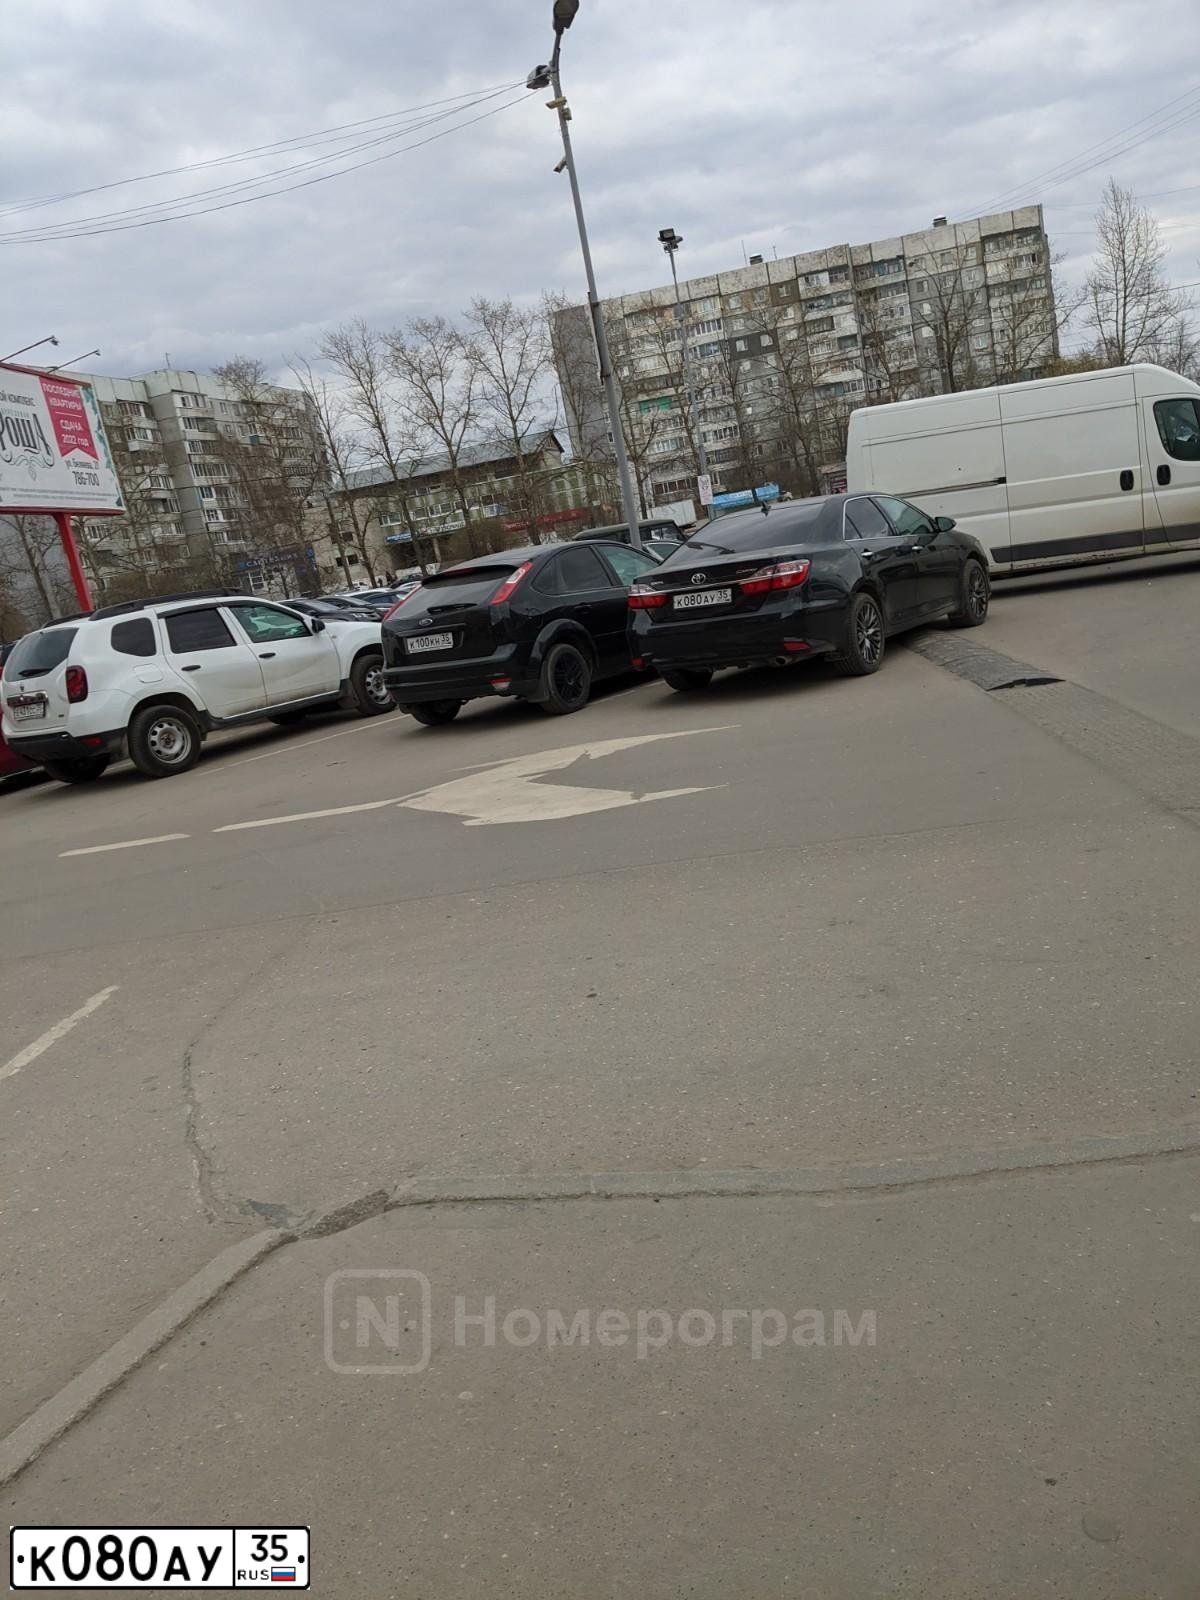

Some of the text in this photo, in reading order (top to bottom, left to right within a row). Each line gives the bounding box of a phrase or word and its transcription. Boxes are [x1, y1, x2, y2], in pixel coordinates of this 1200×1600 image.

[677, 590, 728, 607] К080АУ 35
[441, 634, 450, 642] 35
